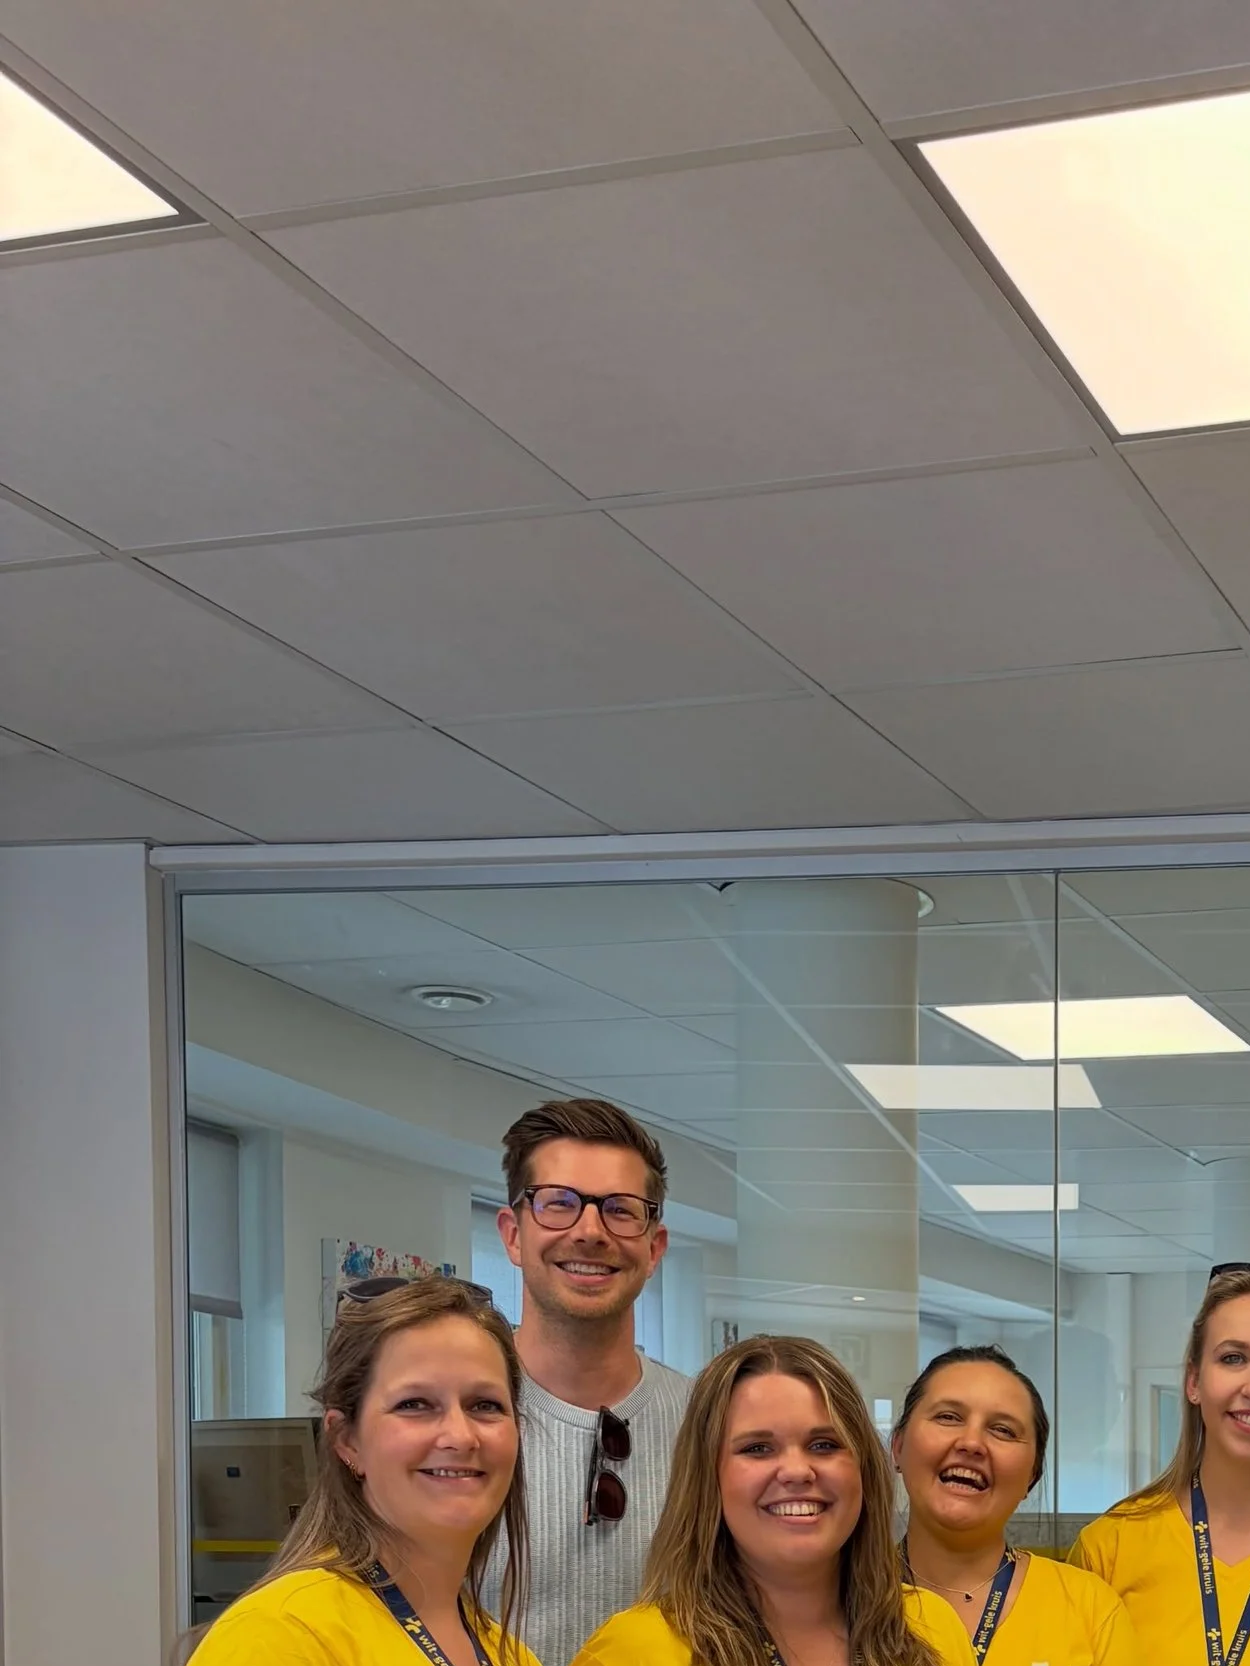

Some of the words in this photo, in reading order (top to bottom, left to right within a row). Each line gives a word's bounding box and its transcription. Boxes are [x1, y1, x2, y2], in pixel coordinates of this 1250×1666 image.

[1199, 1534, 1210, 1571] wit-gele
[1202, 1571, 1213, 1595] kruis
[978, 1610, 995, 1643] wit-gele
[988, 1590, 1002, 1612] kruis
[1231, 1629, 1247, 1655] kruis
